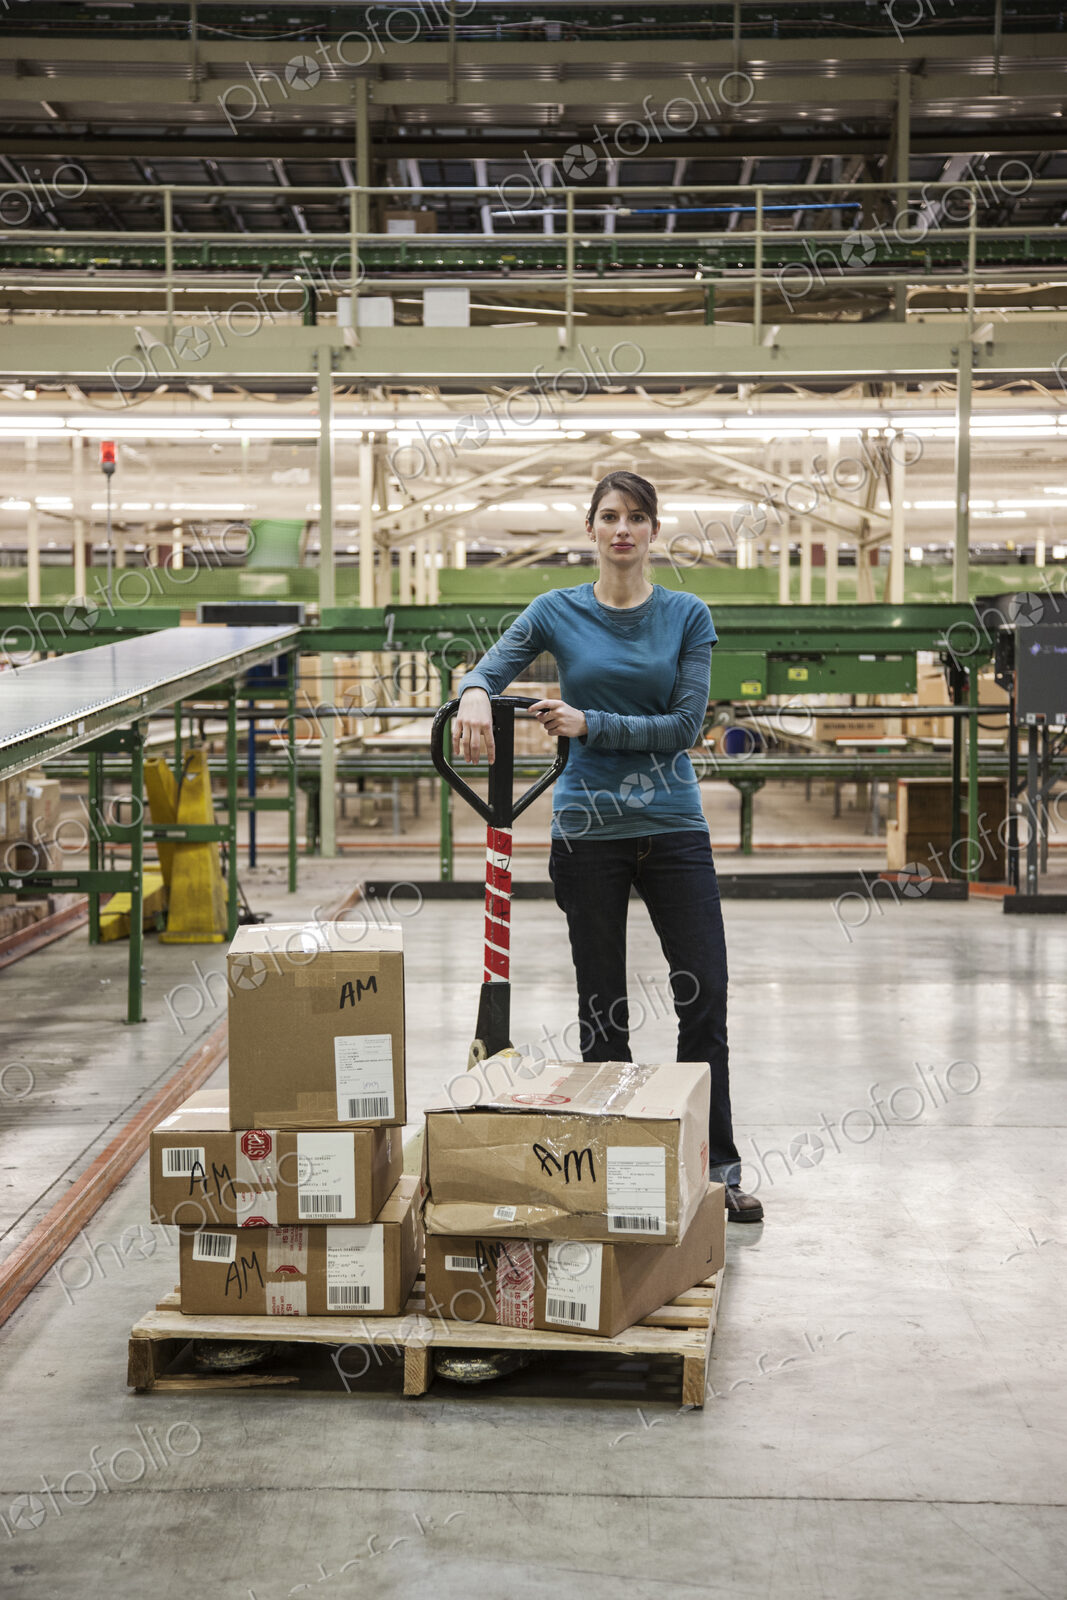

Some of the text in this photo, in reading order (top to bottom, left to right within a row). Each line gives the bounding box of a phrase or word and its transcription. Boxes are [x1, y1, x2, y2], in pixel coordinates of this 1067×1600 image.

[340, 976, 378, 1009] AM
[189, 1160, 237, 1205] AM
[533, 1144, 596, 1184] AM
[225, 1252, 264, 1299] AM
[476, 1240, 520, 1278] AM
